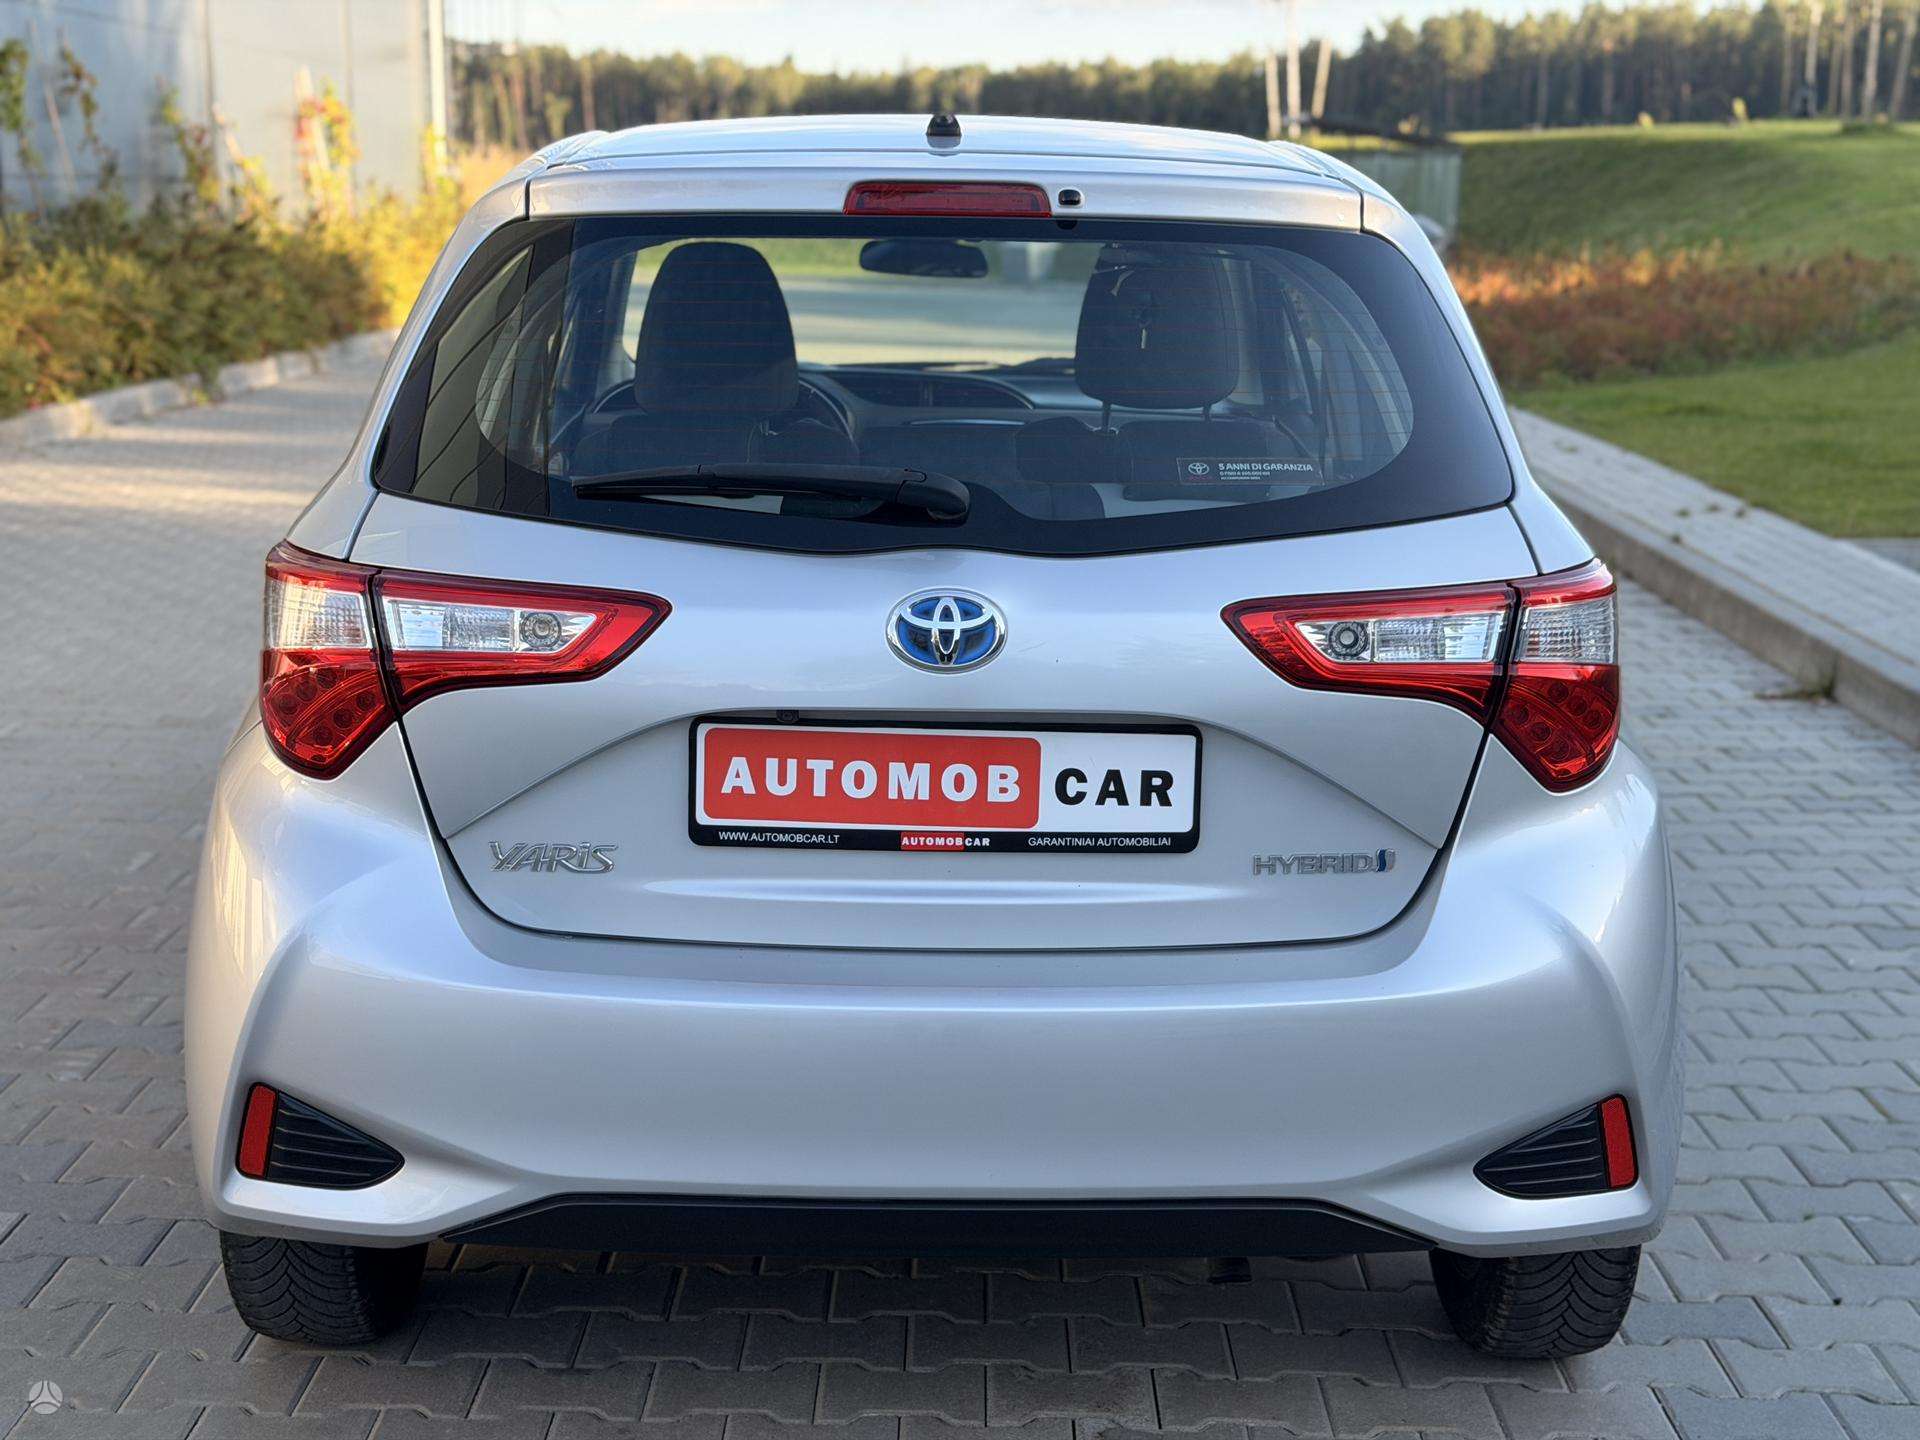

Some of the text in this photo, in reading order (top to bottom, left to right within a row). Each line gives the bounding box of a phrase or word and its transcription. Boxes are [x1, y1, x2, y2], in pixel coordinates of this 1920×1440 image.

[1218, 463, 1313, 472] 5 ANNI DI GARANZIA
[721, 756, 1174, 807] AUTOMOB CAR
[718, 831, 841, 845] WWW.AUTOMOBCAR.LT
[1027, 837, 1172, 847] GARANTINIAI AUTOMOBILIAI
[1253, 853, 1376, 875] HYBRID
